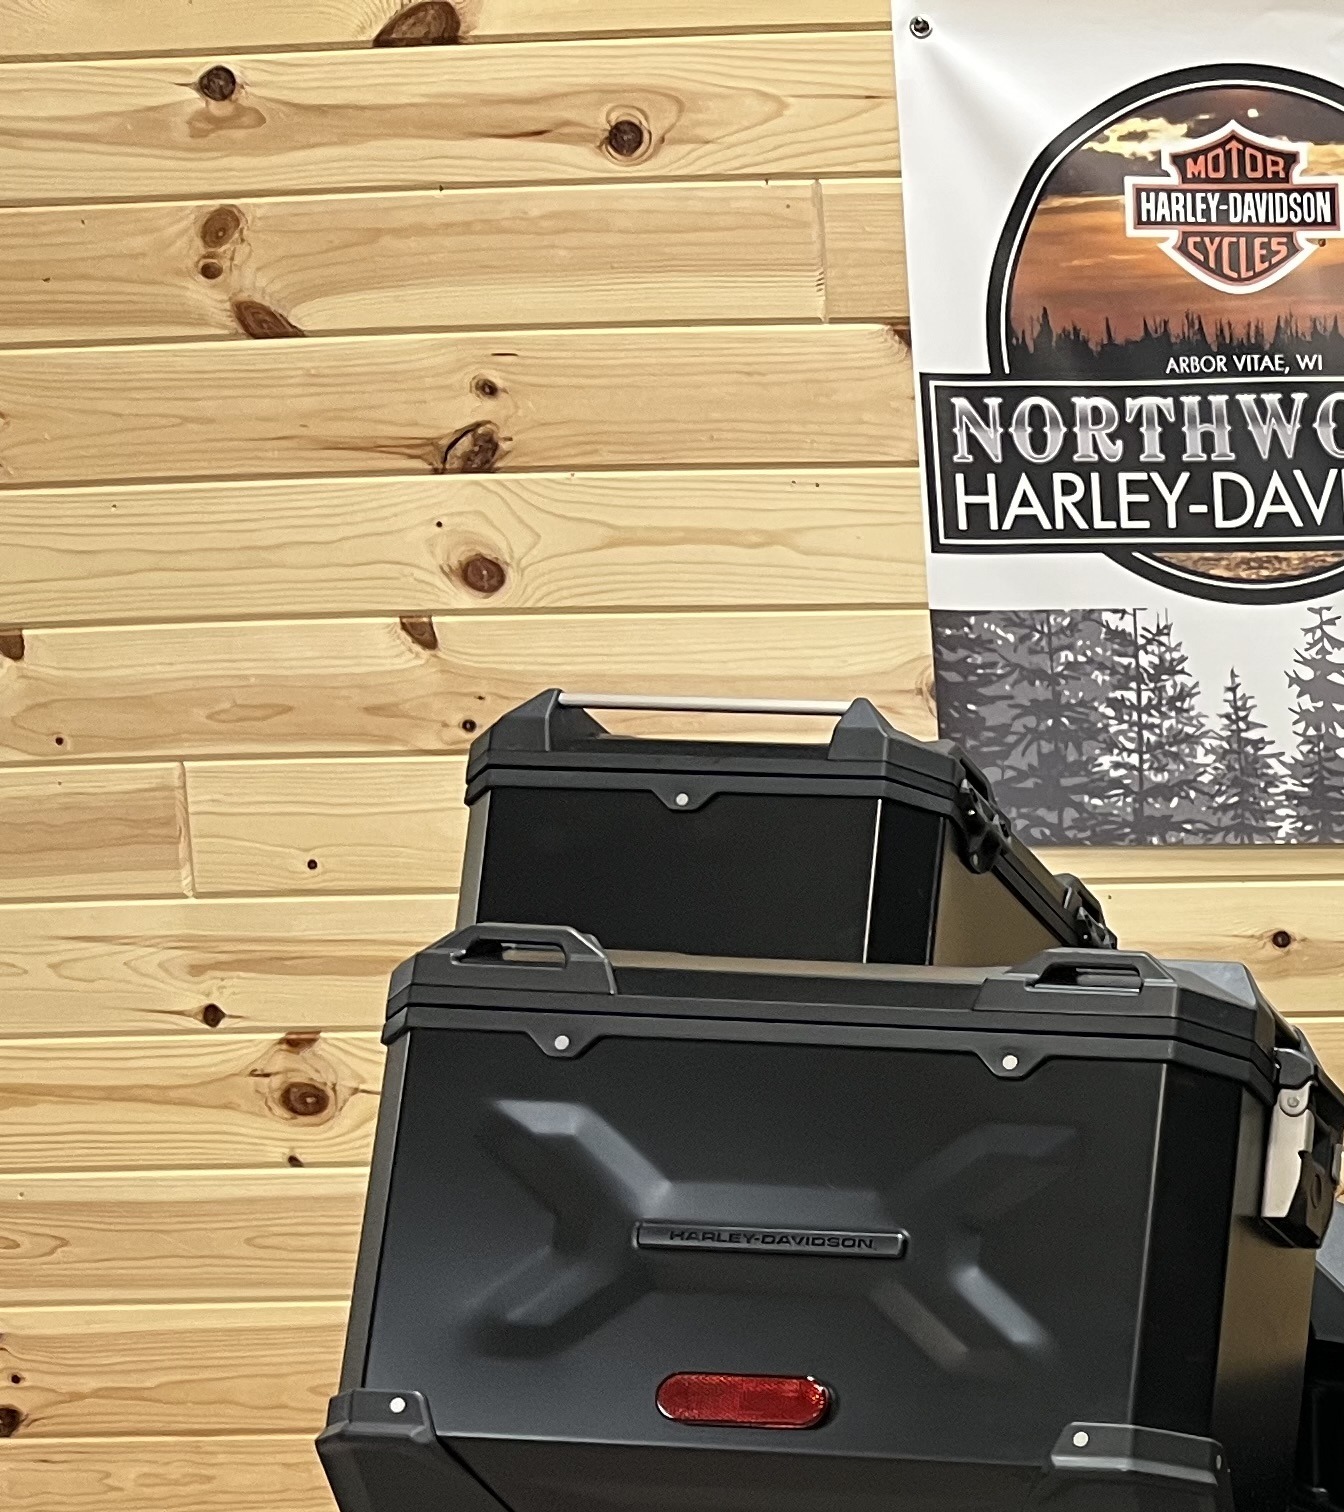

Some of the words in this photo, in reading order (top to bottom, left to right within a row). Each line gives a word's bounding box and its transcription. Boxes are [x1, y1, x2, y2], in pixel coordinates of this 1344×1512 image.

[1186, 138, 1286, 179] MOTOR
[1140, 191, 1331, 224] HARLEY-DAVIDSON
[1187, 236, 1288, 279] CYCLES
[1165, 355, 1228, 375] ARBOR
[1232, 353, 1290, 375] VITAE,
[1295, 353, 1323, 371] WI
[669, 1229, 874, 1250] HARLEY-DAVIDSON
